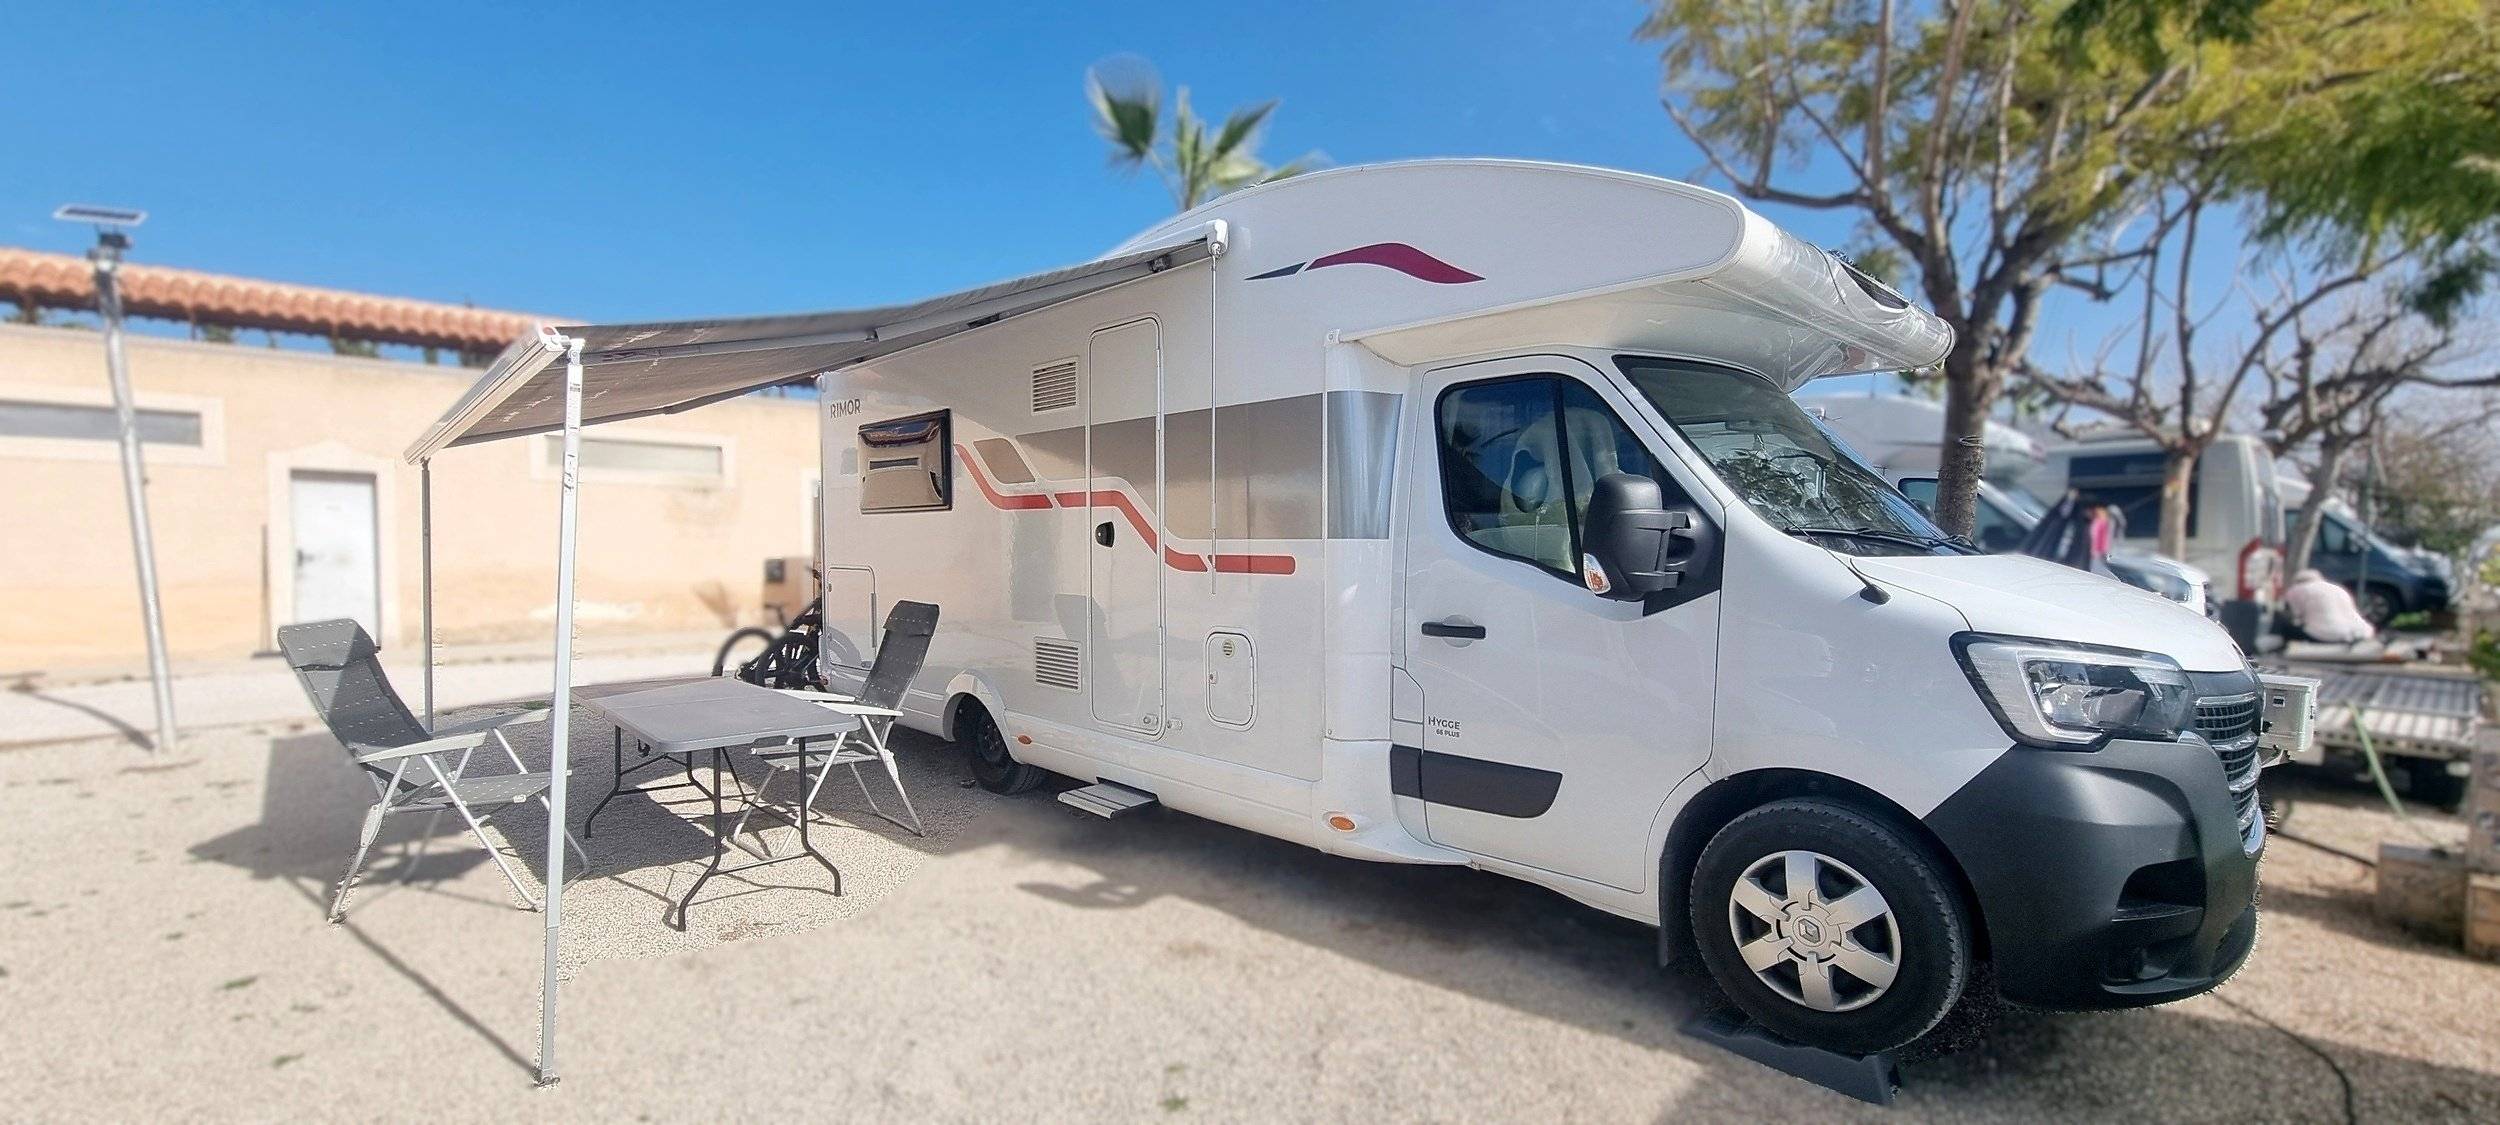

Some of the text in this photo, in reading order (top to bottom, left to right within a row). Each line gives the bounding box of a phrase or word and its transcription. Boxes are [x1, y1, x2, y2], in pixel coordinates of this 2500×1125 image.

[830, 398, 861, 418] RIMOR
[1428, 715, 1461, 730] HYGGE
[1444, 729, 1460, 738] PLUS
